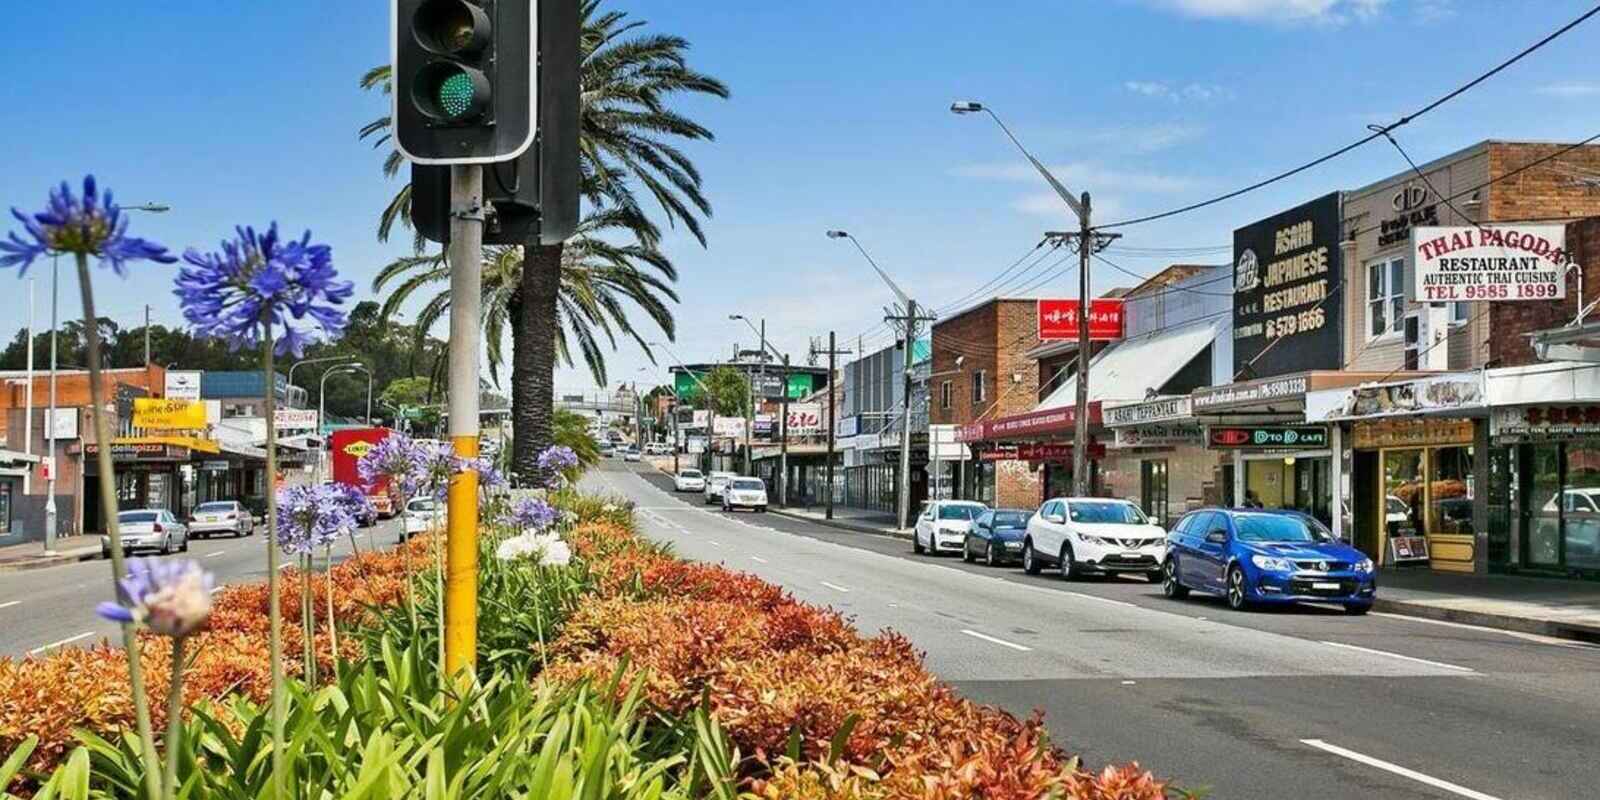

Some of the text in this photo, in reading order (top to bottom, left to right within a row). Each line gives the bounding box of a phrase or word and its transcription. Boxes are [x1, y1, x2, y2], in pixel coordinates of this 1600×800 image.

[1275, 220, 1313, 255] ASAHI
[1418, 230, 1474, 261] THAI
[1479, 228, 1564, 265] PAGODA
[1264, 246, 1328, 288] JAPANESE
[1423, 271, 1557, 286] AUTHENTIC THAI CUISINE
[1439, 257, 1540, 272] RESTAURANT
[1264, 279, 1328, 313] RESTAURANT
[1424, 284, 1557, 299] TEL 9585 1899
